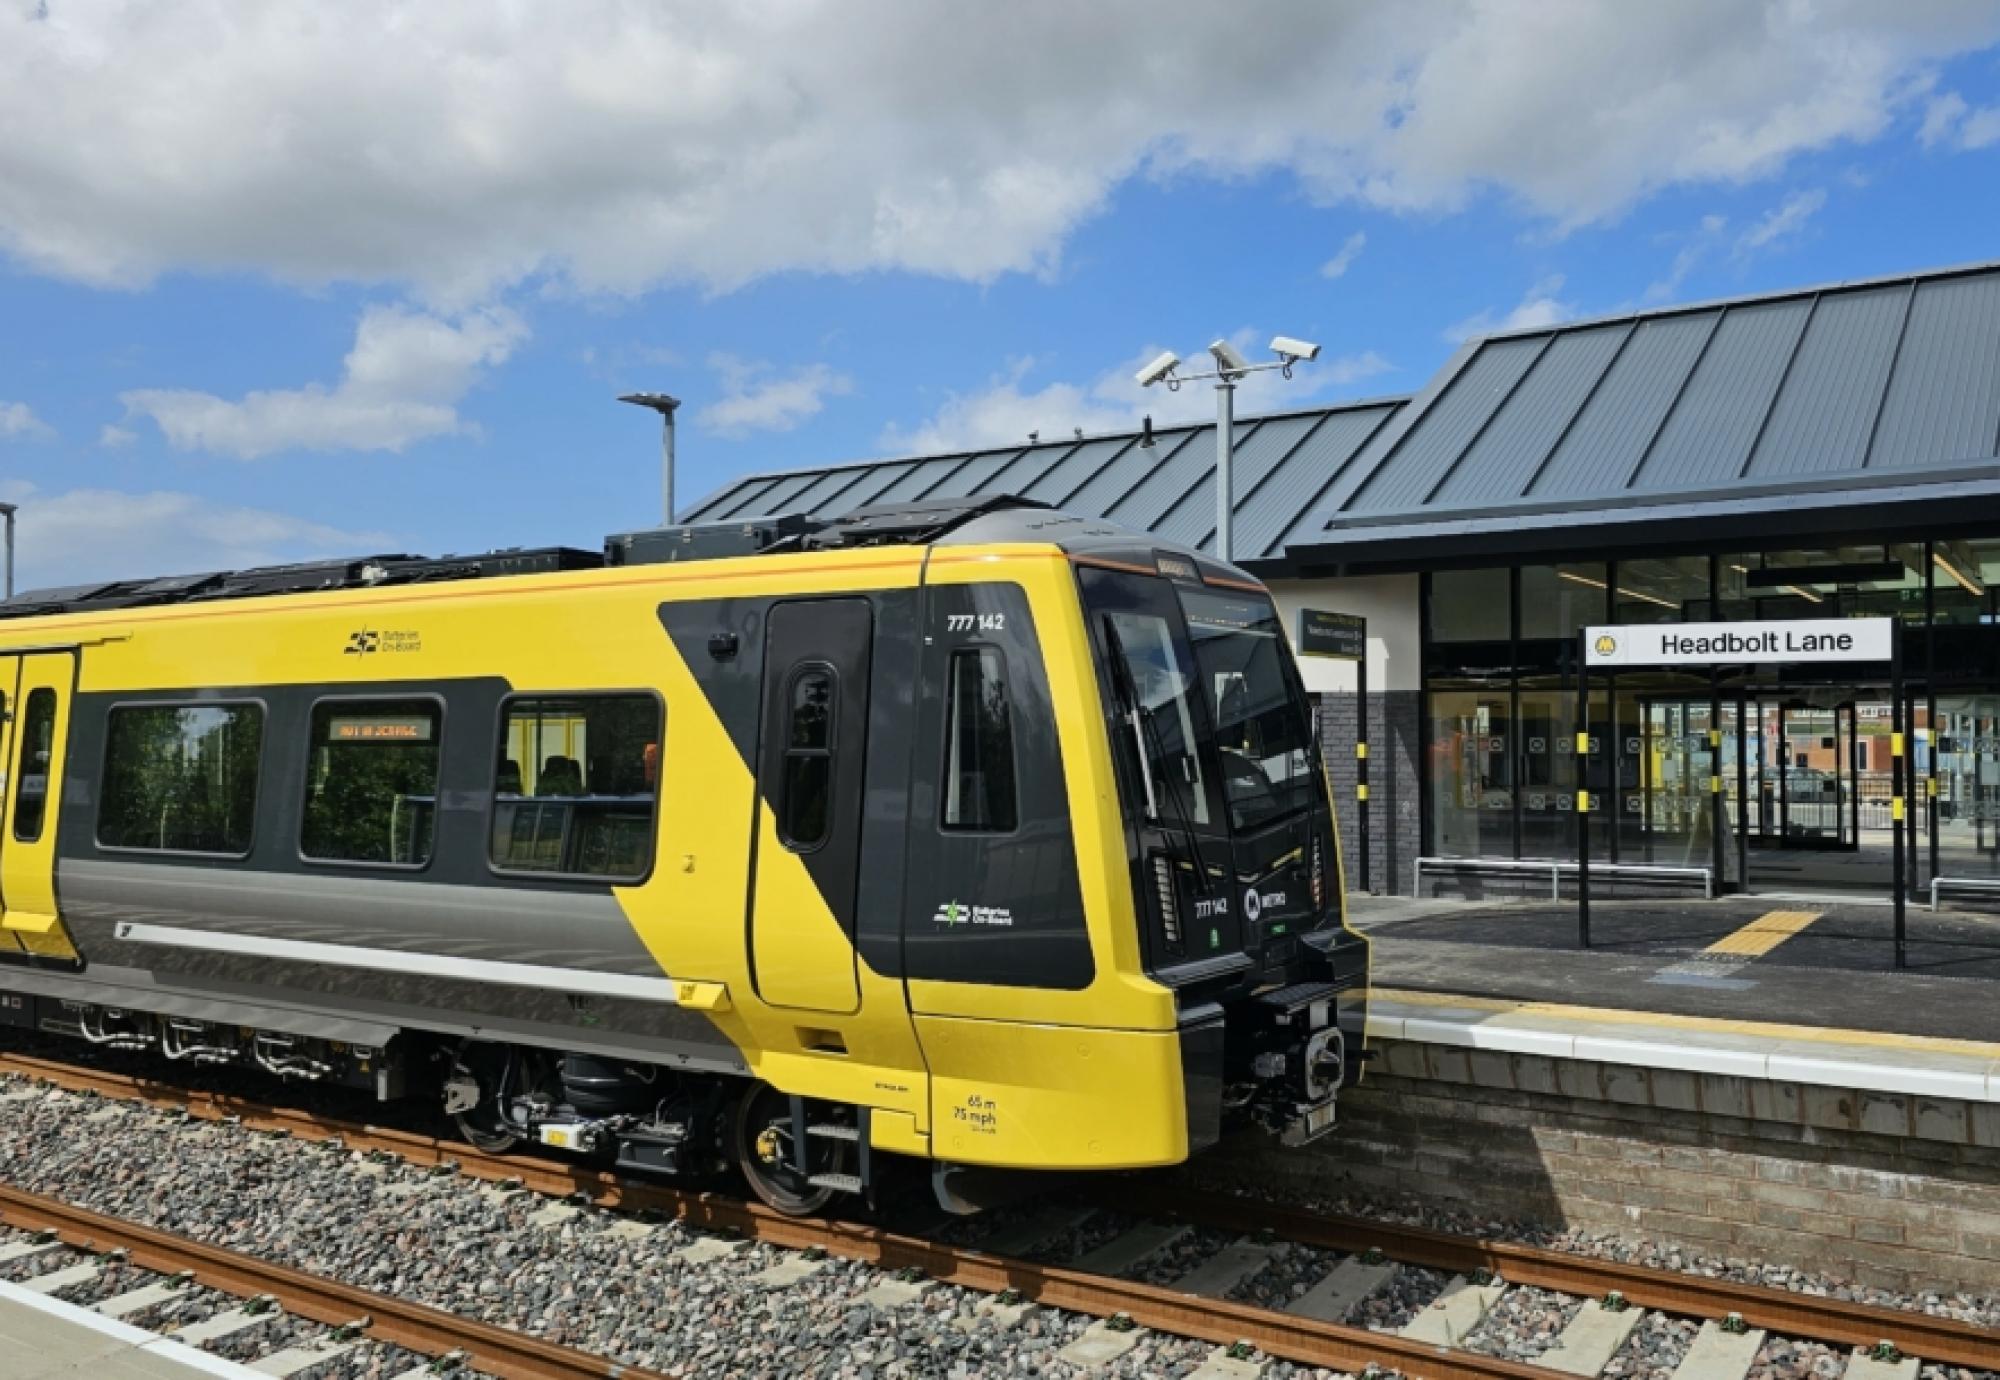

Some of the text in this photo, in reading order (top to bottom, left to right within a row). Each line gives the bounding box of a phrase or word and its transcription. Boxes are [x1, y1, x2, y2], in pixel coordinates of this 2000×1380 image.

[947, 612, 1005, 631] 777 142
[1662, 631, 1853, 655] Headbolt Lane
[1195, 897, 1227, 919] 777 142
[970, 1111, 996, 1126] mph
